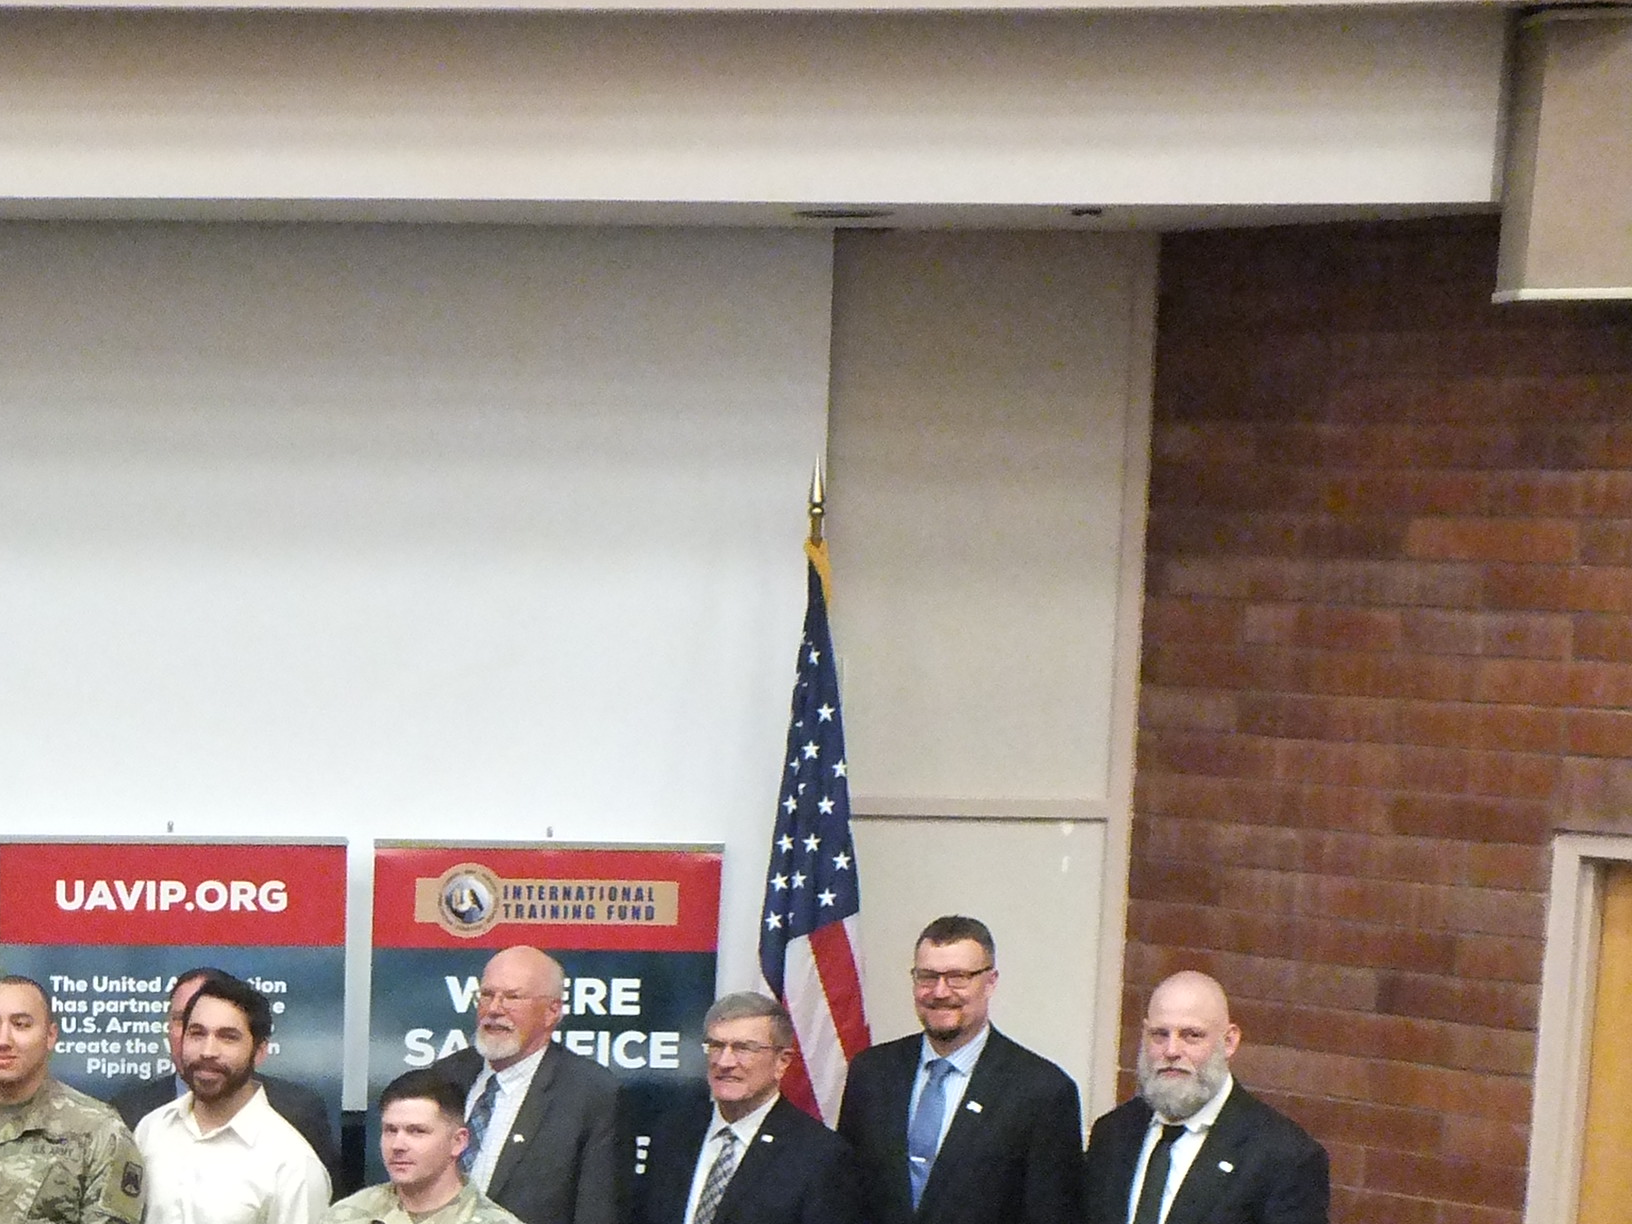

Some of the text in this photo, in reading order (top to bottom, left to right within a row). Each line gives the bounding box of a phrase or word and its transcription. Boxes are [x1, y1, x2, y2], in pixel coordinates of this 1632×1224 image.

[55, 880, 288, 912] UAVIP.ORG
[502, 884, 655, 902] INTERNATIONAL
[502, 903, 656, 921] TRAINING FUND
[50, 976, 87, 993] The
[92, 975, 161, 993] United
[52, 997, 171, 1017] has partner
[61, 1017, 102, 1034] U.S.
[55, 1039, 121, 1054] create
[126, 1038, 159, 1054] the
[86, 1058, 151, 1079] Piping
